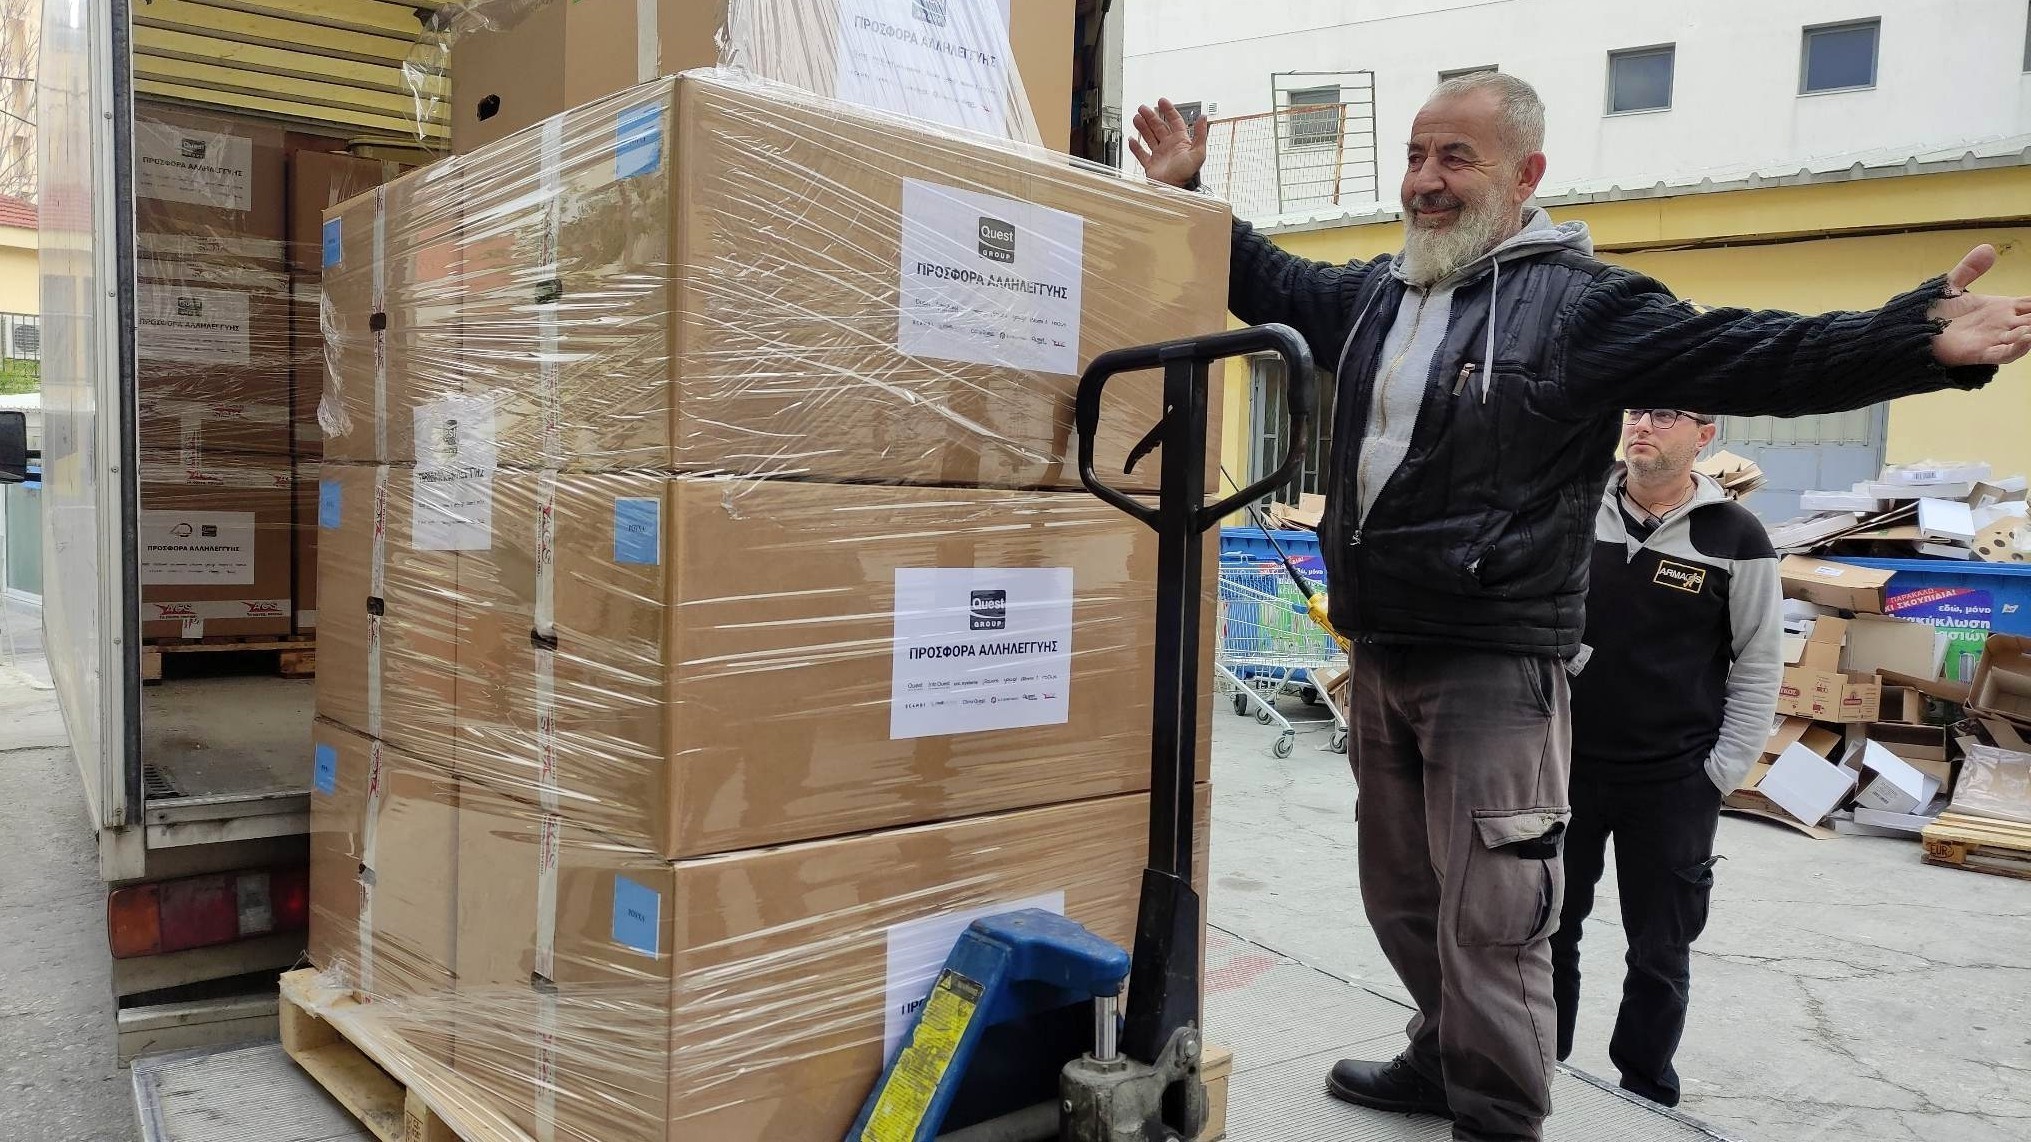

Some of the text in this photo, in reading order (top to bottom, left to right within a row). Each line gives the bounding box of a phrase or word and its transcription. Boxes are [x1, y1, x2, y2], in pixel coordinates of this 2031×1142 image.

[854, 16, 918, 45] ΠΡΟΣΦΟΡΑ
[980, 224, 1014, 243] Quest
[982, 249, 1012, 259] GROUP
[916, 262, 1068, 300] ΠΡΟΣΦΟΡΑ ΑΛΛΗΛΕΓΓΥΗΣ
[541, 513, 552, 565] ACS
[167, 602, 277, 612] ACS ACS
[972, 597, 1005, 611] Quest
[1897, 588, 1957, 609] ΣΚΟΥΠΙΔΙΑ!
[1938, 604, 1992, 615] εδώ, μόνο
[973, 620, 1002, 628] GROUP
[909, 640, 1058, 660] ΠΡΟΣΦΟΡΑ ΑΛΛΗΛΕΓΓΥΗΣ
